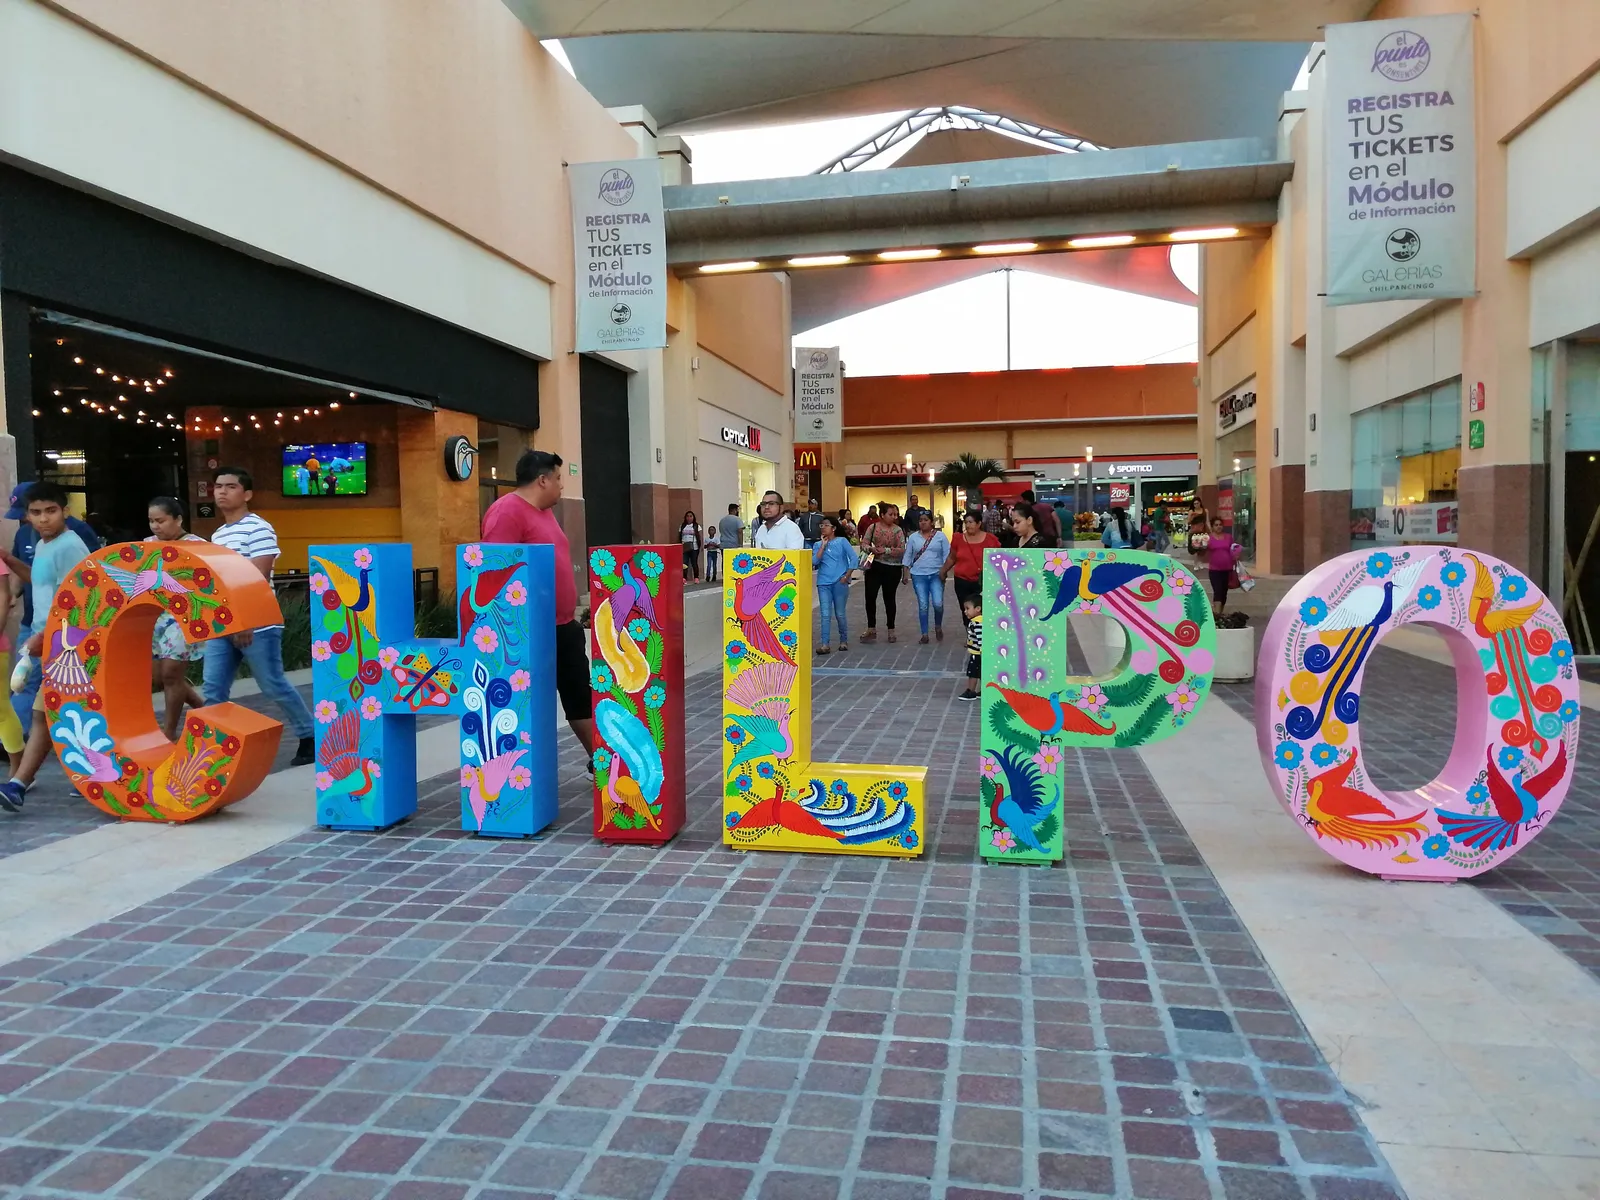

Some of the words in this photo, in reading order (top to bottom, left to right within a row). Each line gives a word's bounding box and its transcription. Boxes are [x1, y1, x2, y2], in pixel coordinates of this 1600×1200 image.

[1396, 32, 1407, 46] el
[1371, 37, 1429, 72] punto
[1347, 91, 1454, 114] REGISTRA
[1348, 114, 1404, 137] TUS
[1348, 135, 1454, 159] TICKETS
[612, 170, 619, 179] el
[1348, 164, 1380, 181] en
[1386, 157, 1407, 176] el
[598, 174, 633, 199] punto
[1348, 178, 1454, 206] Módulo
[1348, 210, 1367, 221] de
[1370, 203, 1456, 219] Información
[586, 213, 651, 227] REGISTRA
[587, 228, 620, 243] TUS
[588, 243, 652, 258] TICKETS
[588, 261, 607, 272] en
[611, 257, 623, 270] el
[588, 272, 652, 288] Módulo
[1369, 283, 1435, 292] CHILPANCINGO
[589, 290, 600, 298] de
[602, 288, 653, 297] Información
[801, 402, 834, 410] Módulo
[871, 463, 926, 474] QUARRY
[1116, 465, 1152, 473] SPORTICO
[1392, 507, 1405, 535] 10
